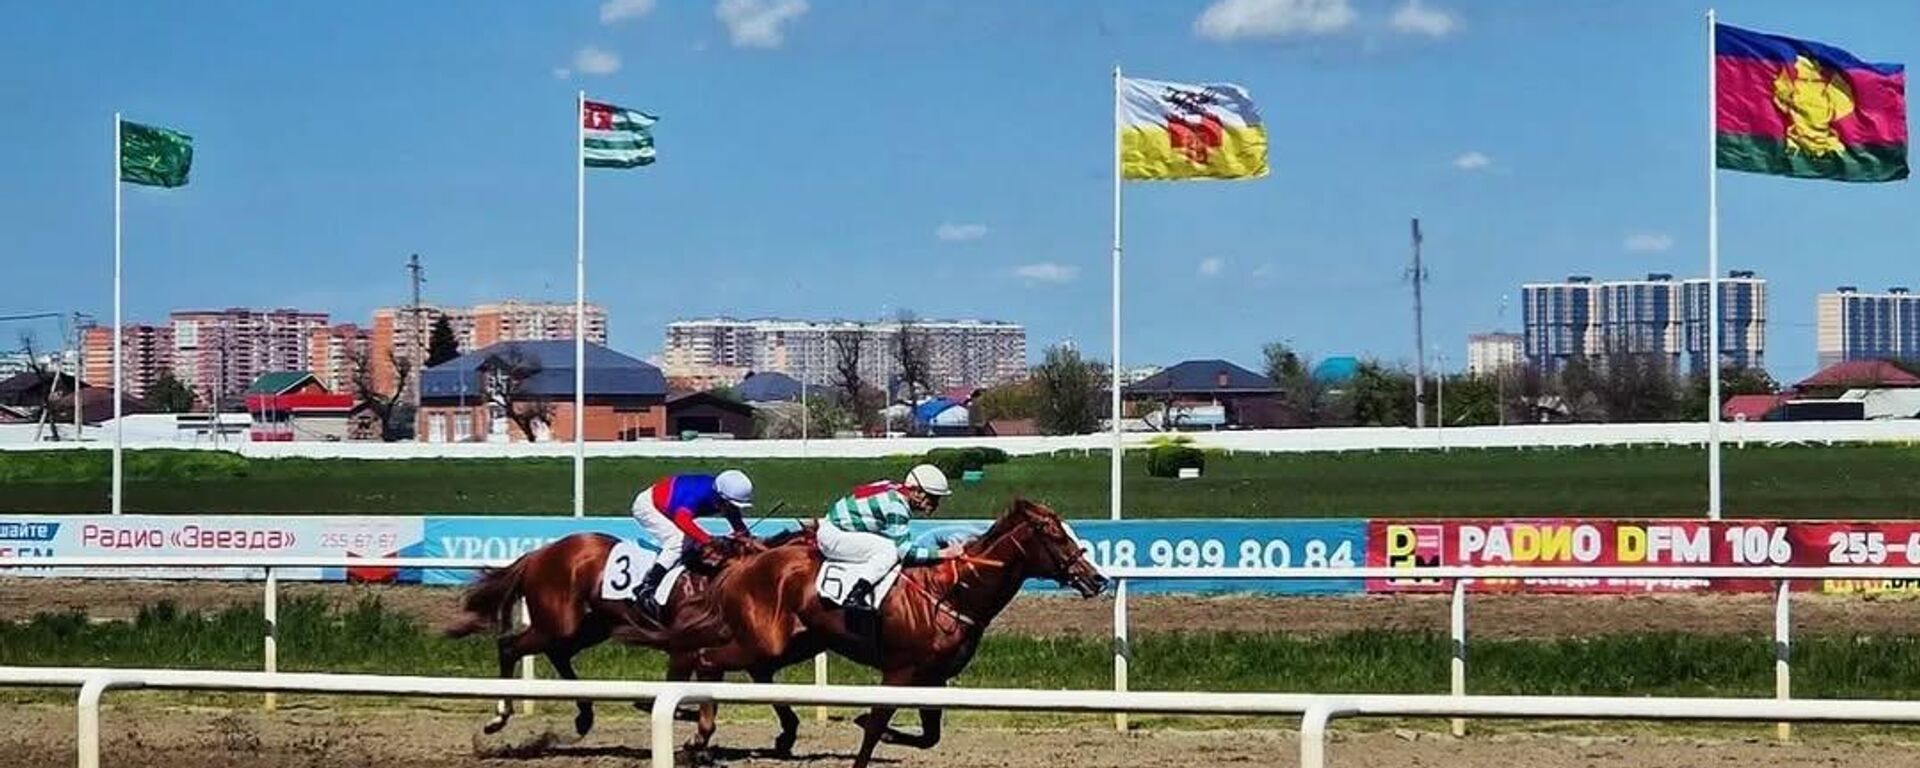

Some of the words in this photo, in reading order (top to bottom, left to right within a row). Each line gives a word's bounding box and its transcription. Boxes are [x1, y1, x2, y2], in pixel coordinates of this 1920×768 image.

[83, 524, 164, 548] Радио
[171, 525, 296, 549] «Звезда»
[441, 536, 550, 561] УРОК
[1617, 525, 1711, 562] DFM
[1726, 526, 1792, 564] 106
[1149, 539, 1226, 568] 999
[1238, 539, 1292, 568] 80
[1304, 539, 1356, 568] 84
[611, 555, 631, 591] 3
[821, 564, 846, 600] 6
